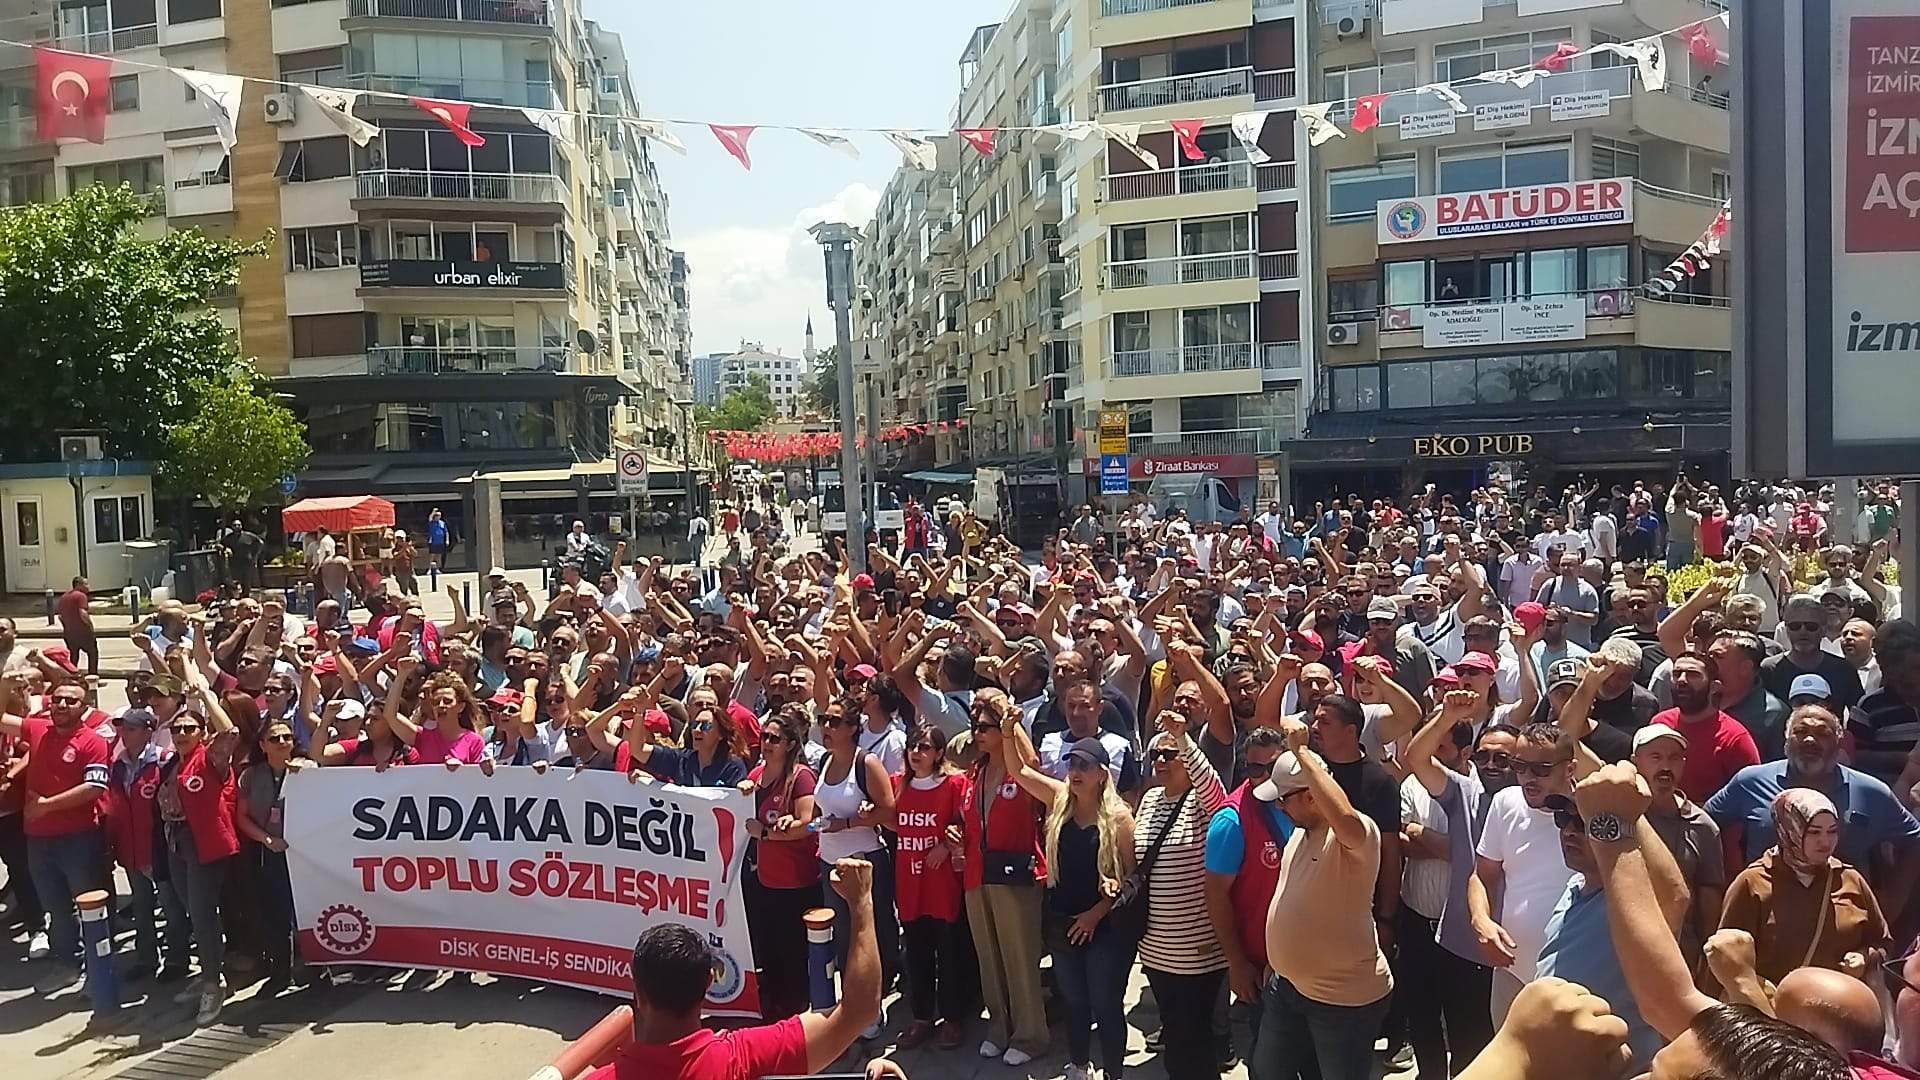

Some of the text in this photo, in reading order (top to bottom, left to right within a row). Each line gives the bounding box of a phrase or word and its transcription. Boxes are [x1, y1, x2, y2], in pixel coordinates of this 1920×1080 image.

[1866, 69, 1920, 94] İZMİR
[1436, 181, 1623, 225] BATÜDER
[1439, 223, 1491, 234] ULUSLARARASI
[1491, 221, 1521, 231] BALKAN
[1530, 217, 1549, 227] TÜRK
[1549, 216, 1558, 226] İŞ
[1558, 213, 1589, 224] DÜNYASI
[1589, 210, 1622, 222] DERNEĞİ
[434, 262, 522, 286] urban elixir
[1413, 434, 1534, 456] EKO PUB
[1155, 460, 1219, 473] Ziraat Bankası
[352, 796, 573, 843] SADAKA
[584, 797, 706, 862] DEĞİL
[898, 809, 937, 827] DİSK
[353, 851, 710, 919] TOPLU SÖZLEŞME
[329, 919, 360, 932] DİSK
[440, 937, 480, 957] DİSK
[485, 943, 560, 969] GENEL-İŞ
